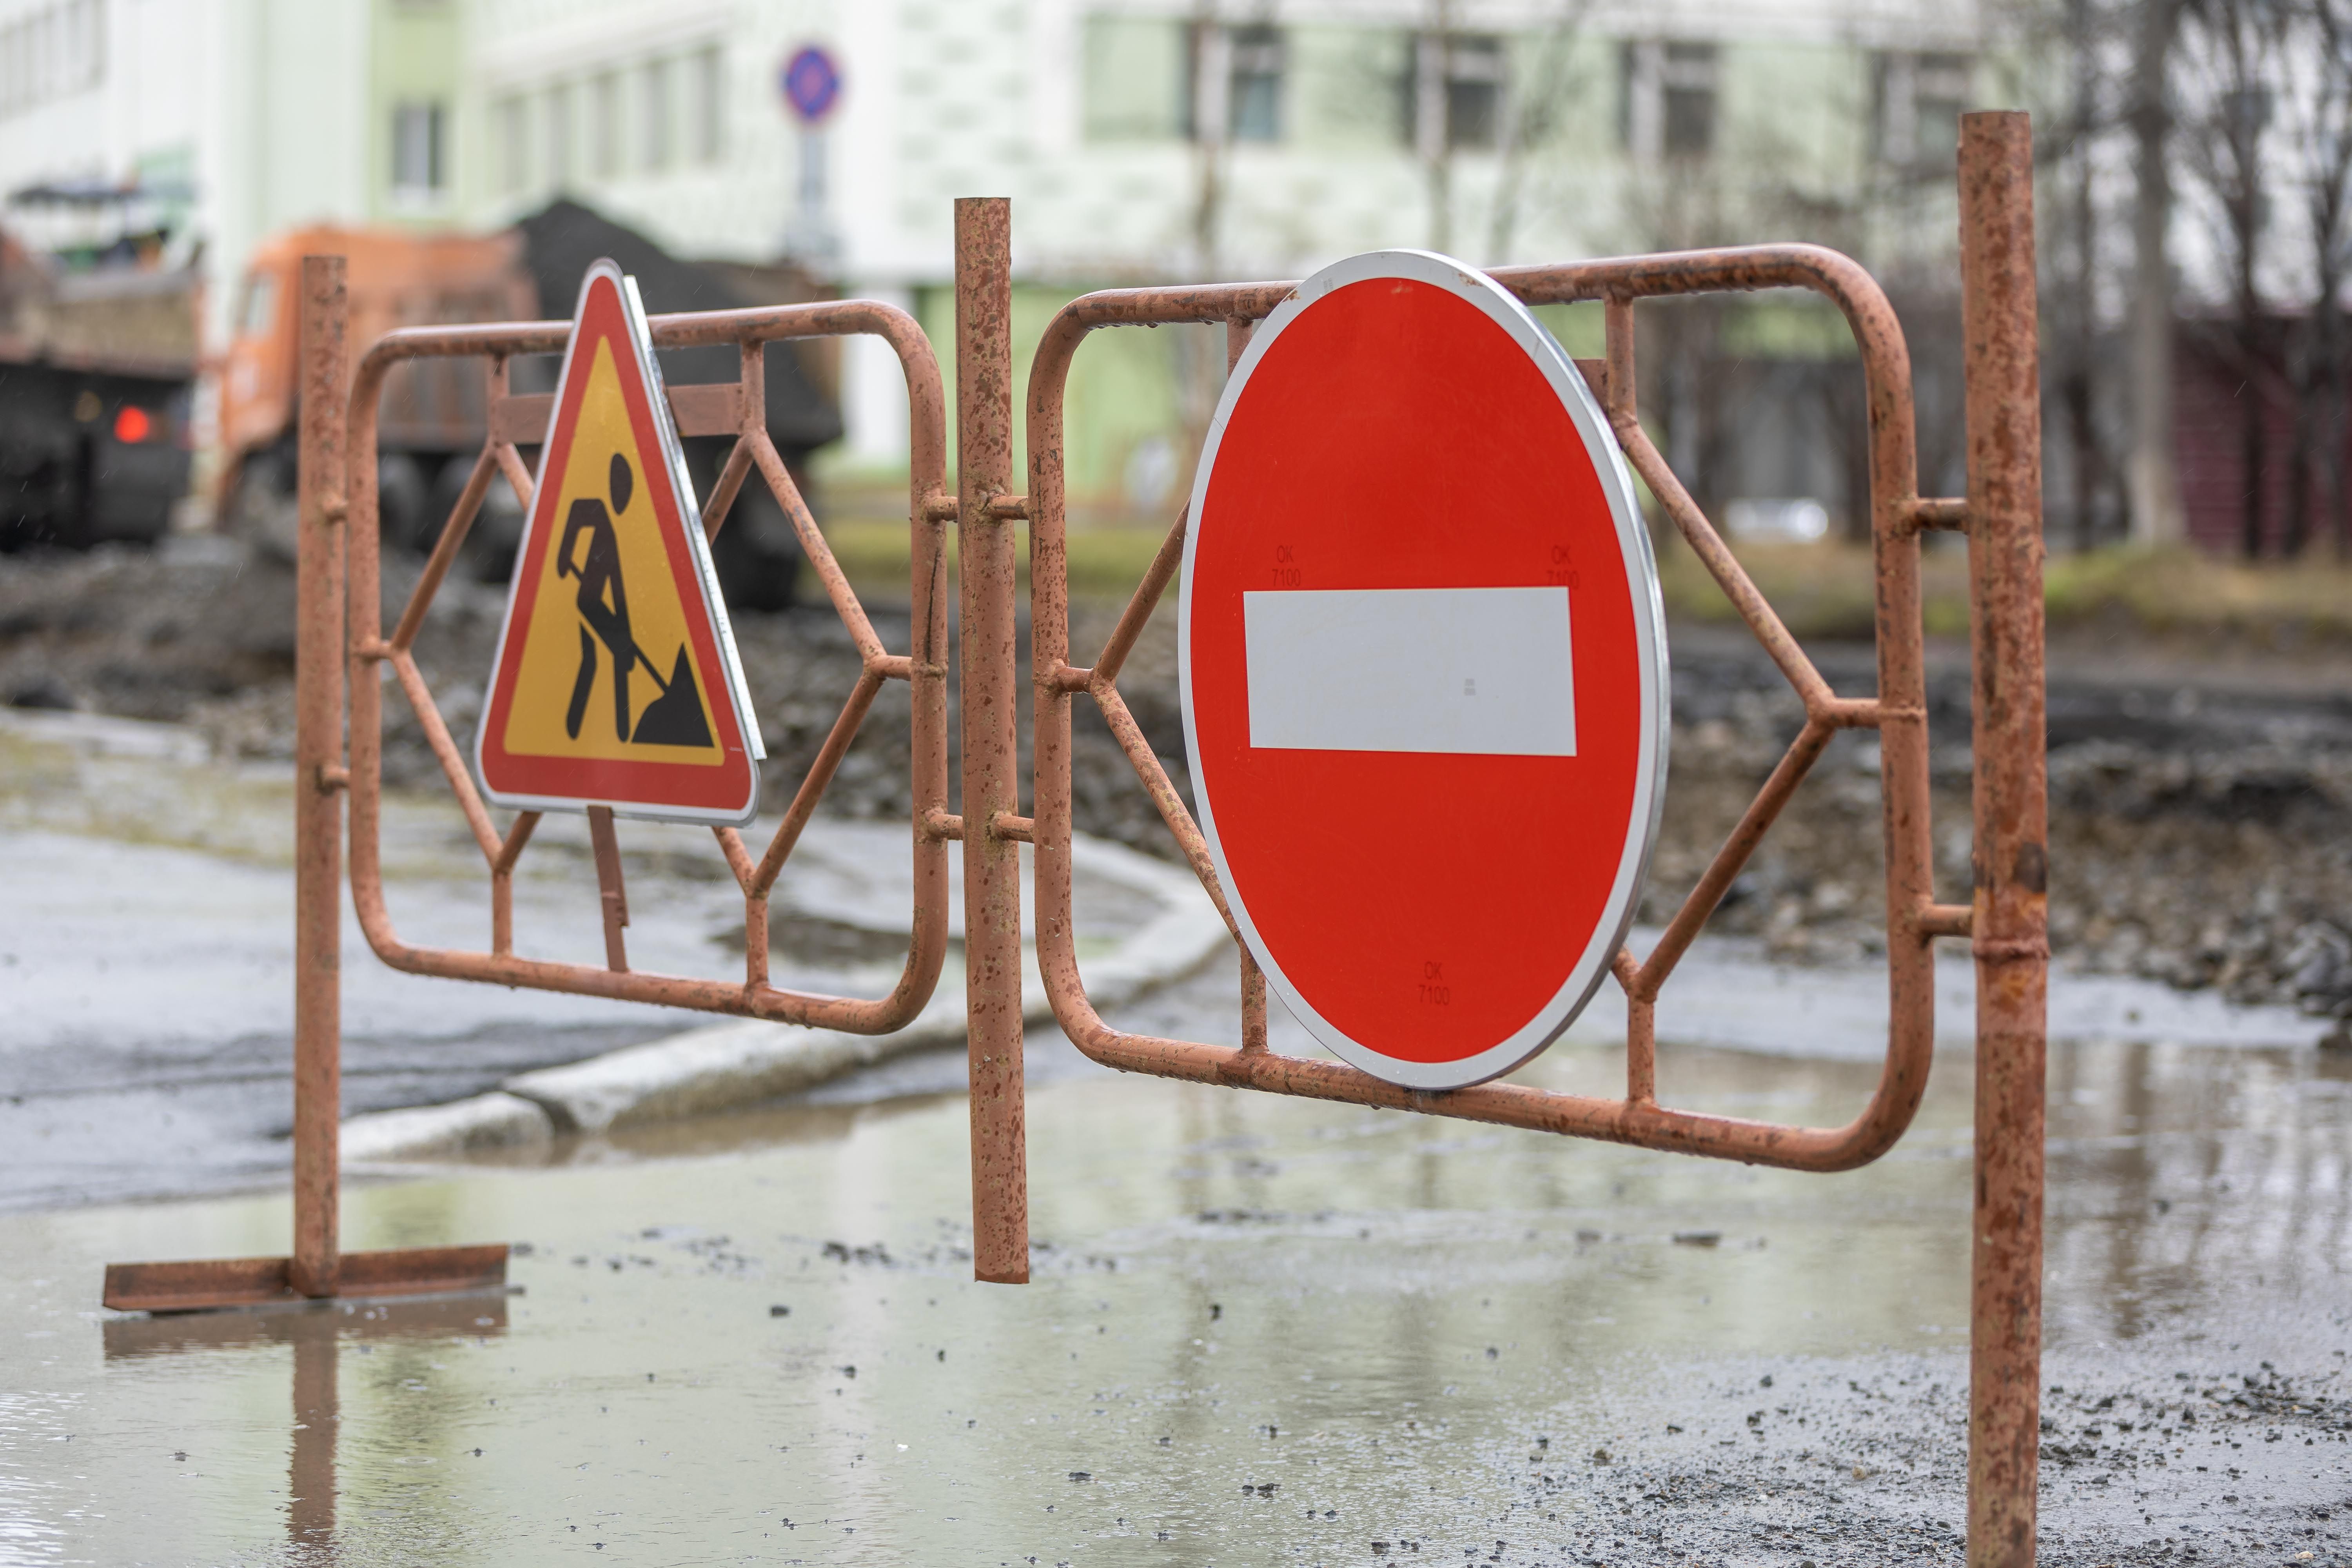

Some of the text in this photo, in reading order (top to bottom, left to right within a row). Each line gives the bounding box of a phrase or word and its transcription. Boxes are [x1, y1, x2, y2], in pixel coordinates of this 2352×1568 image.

[1277, 544, 1294, 563] OK
[1552, 544, 1572, 564] OK
[1272, 568, 1301, 586] 7100
[1424, 961, 1443, 980] OK
[1419, 984, 1450, 1006] 7100
